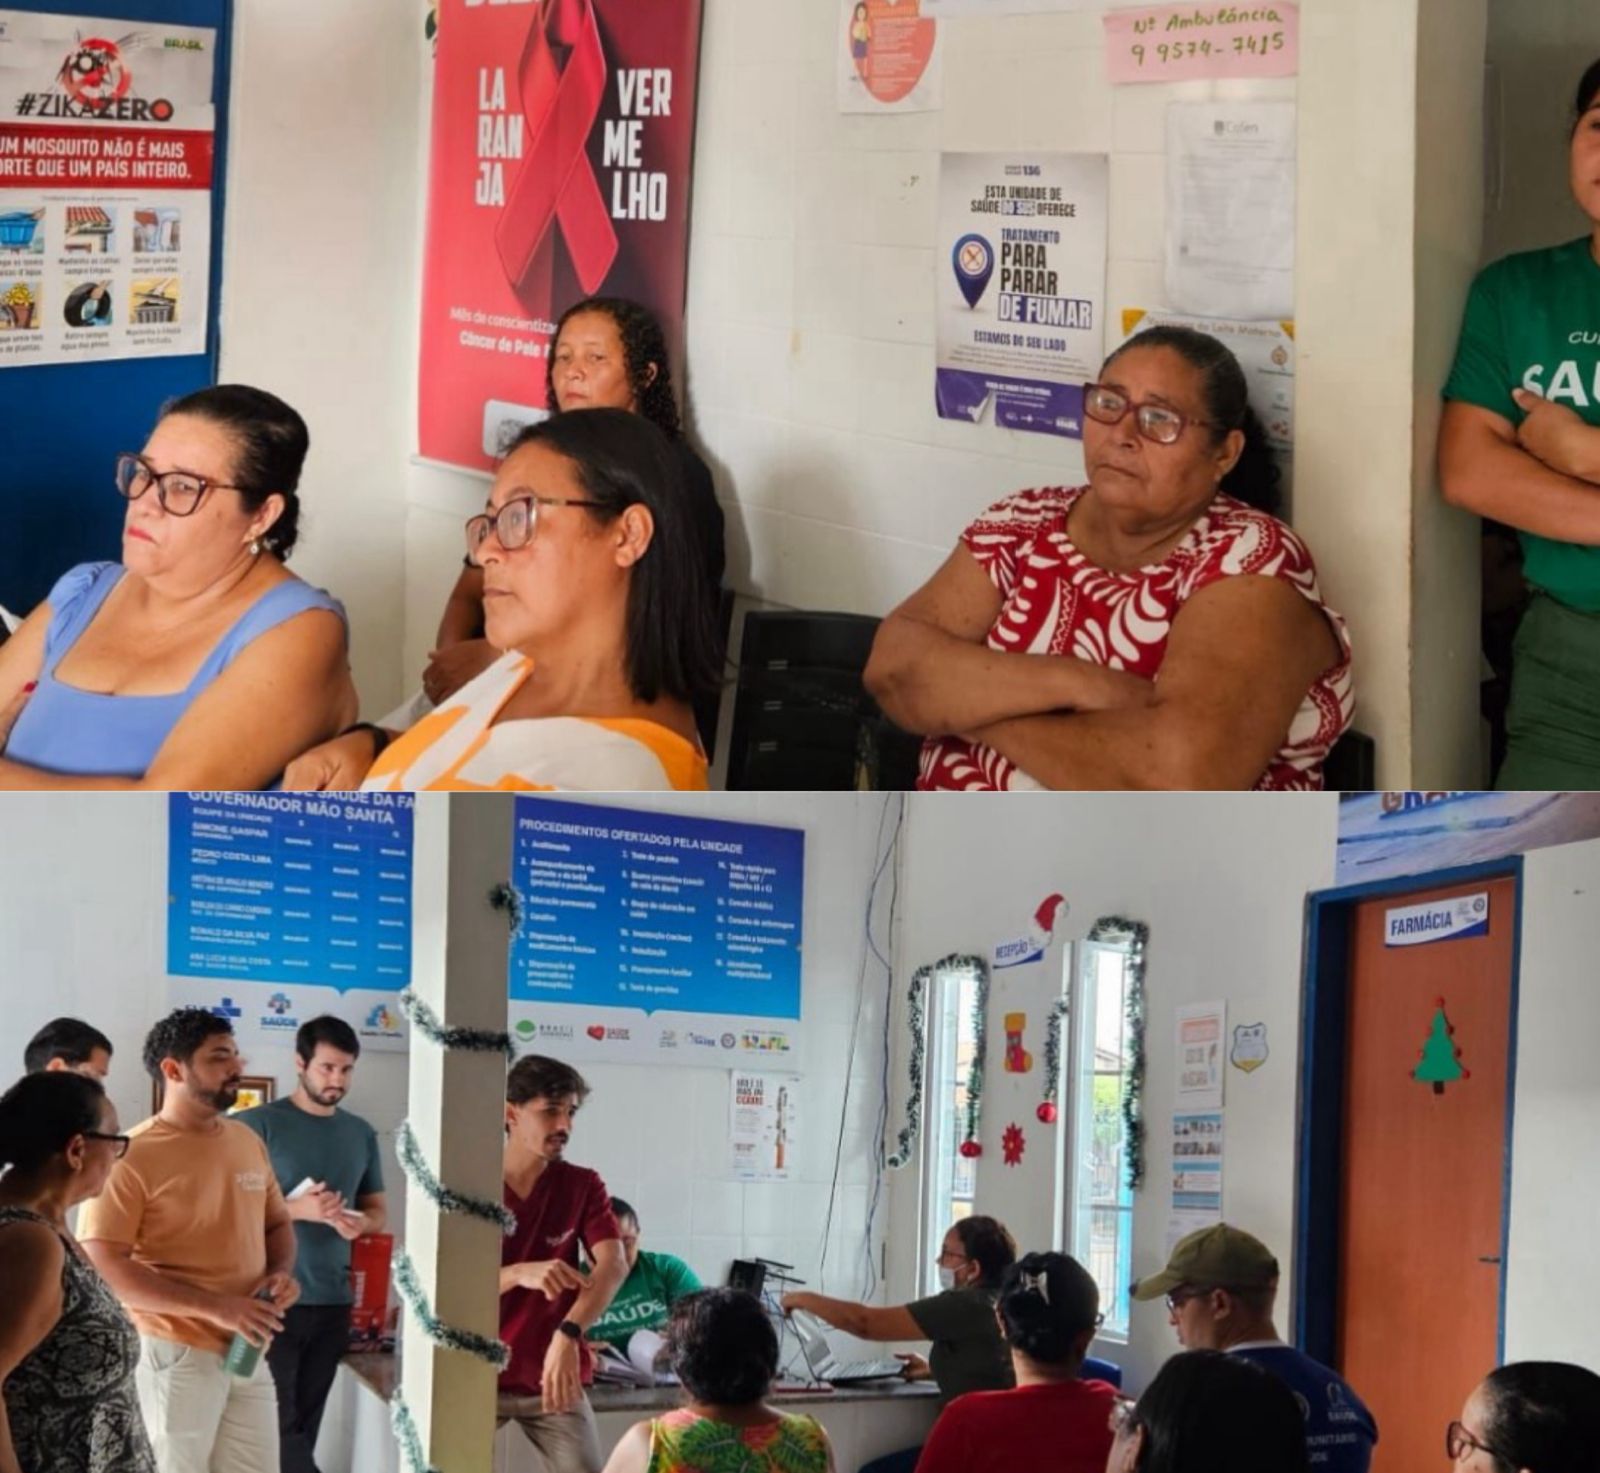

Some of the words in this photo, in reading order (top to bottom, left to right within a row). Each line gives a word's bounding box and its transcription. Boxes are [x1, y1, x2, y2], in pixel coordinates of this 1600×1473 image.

[1131, 45, 1144, 66] 9
[479, 68, 505, 110] LA
[617, 69, 672, 116] VER
[17, 93, 174, 121] #ZIKAZERO
[23, 138, 99, 156] MOSQUITO
[103, 137, 133, 158] NÃO
[136, 138, 146, 158] É
[149, 142, 185, 159] MAIS
[477, 114, 524, 159] RAN
[603, 120, 643, 167] ME
[35, 160, 65, 176] QUE
[69, 160, 92, 177] UM
[96, 158, 129, 178] PAÍS
[132, 161, 191, 179] INTEIRO.
[475, 162, 505, 206] JA
[612, 171, 668, 221] LHO
[985, 185, 1006, 199] ESTA
[1009, 186, 1047, 200] UNIDADE
[1050, 187, 1062, 201] DE
[971, 197, 999, 214] SAÚDE
[1037, 203, 1076, 217] OFERECE
[1001, 228, 1060, 244] TRATAMENTO
[1001, 242, 1047, 269] PARA
[1000, 268, 1058, 296] PARAR
[473, 311, 487, 324] de
[1000, 294, 1021, 321] DE
[1026, 296, 1092, 330] FUMAR
[459, 330, 496, 351] Câncer
[498, 336, 513, 353] de
[514, 339, 541, 357] Pele
[974, 330, 1011, 346] ESTAMOS
[1013, 334, 1024, 346] DO
[1026, 336, 1042, 350] SEU
[1044, 338, 1066, 352] LADO
[1568, 330, 1600, 345] CU
[188, 791, 302, 813] GOVERNADOR
[306, 801, 341, 818] MÃO
[344, 806, 394, 825] SANTA
[519, 818, 609, 839] PROCEDIMENTOS
[611, 829, 671, 846] OFERTADOS
[673, 837, 699, 850] PELA
[700, 839, 744, 855] UNIDADE
[1391, 911, 1453, 937] FARMÁCIA
